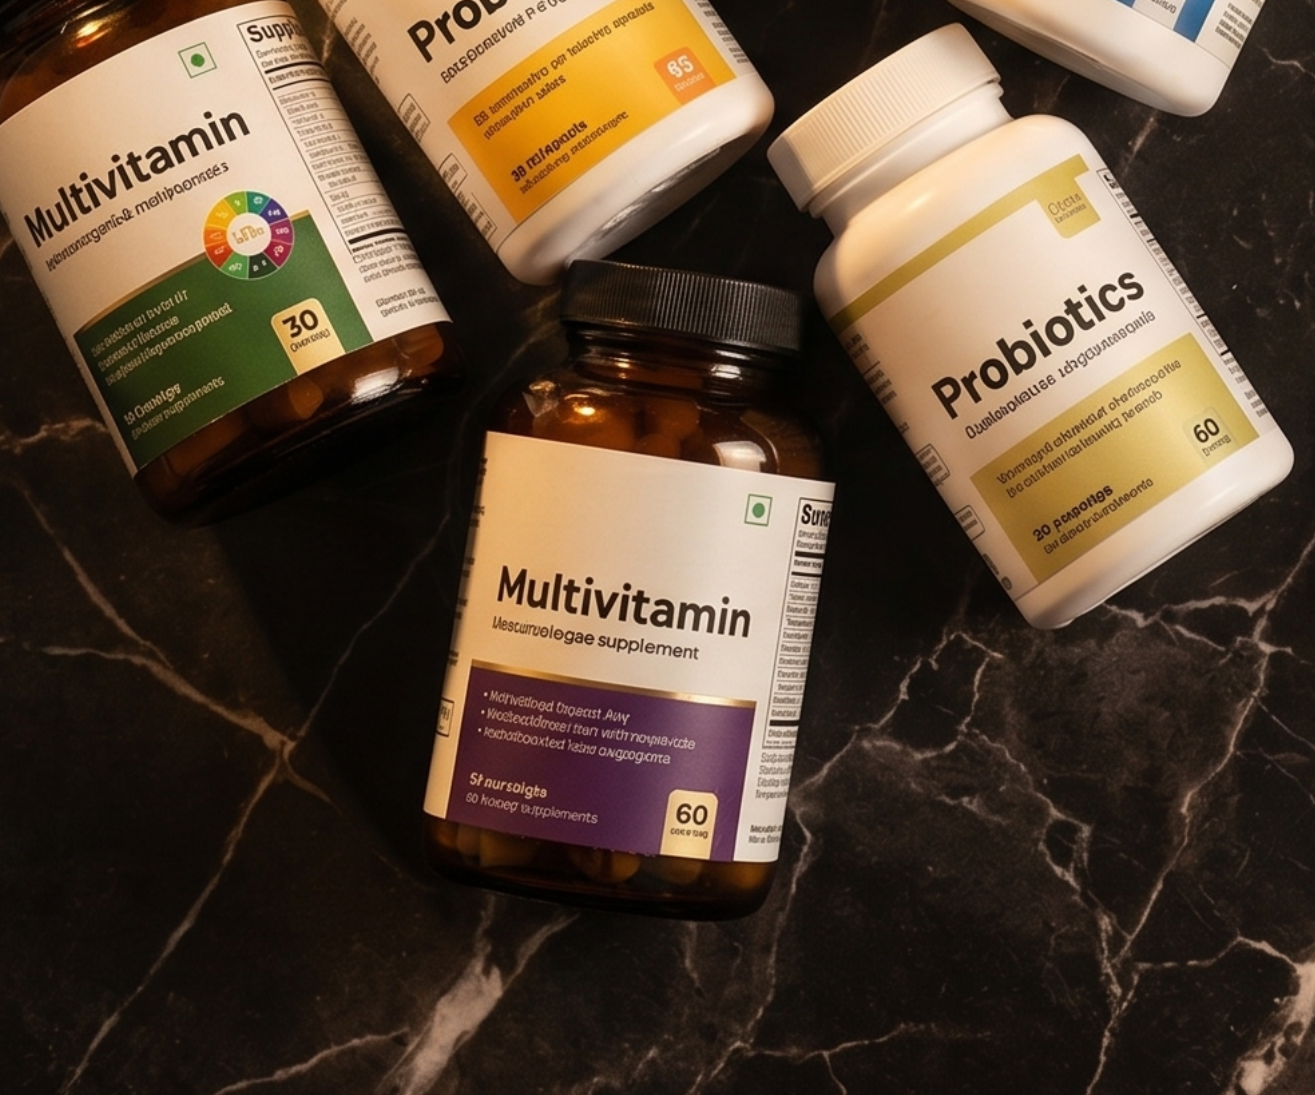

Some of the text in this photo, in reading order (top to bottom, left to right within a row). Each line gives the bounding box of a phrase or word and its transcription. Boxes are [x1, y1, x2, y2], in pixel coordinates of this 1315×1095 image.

[23, 110, 251, 248] Multivitamin
[281, 309, 319, 339] 30
[931, 271, 1145, 420] Probiotics
[1193, 417, 1220, 444] 60
[496, 565, 751, 638] Multivitamin
[597, 635, 700, 661] supplement
[675, 802, 709, 826] 60
